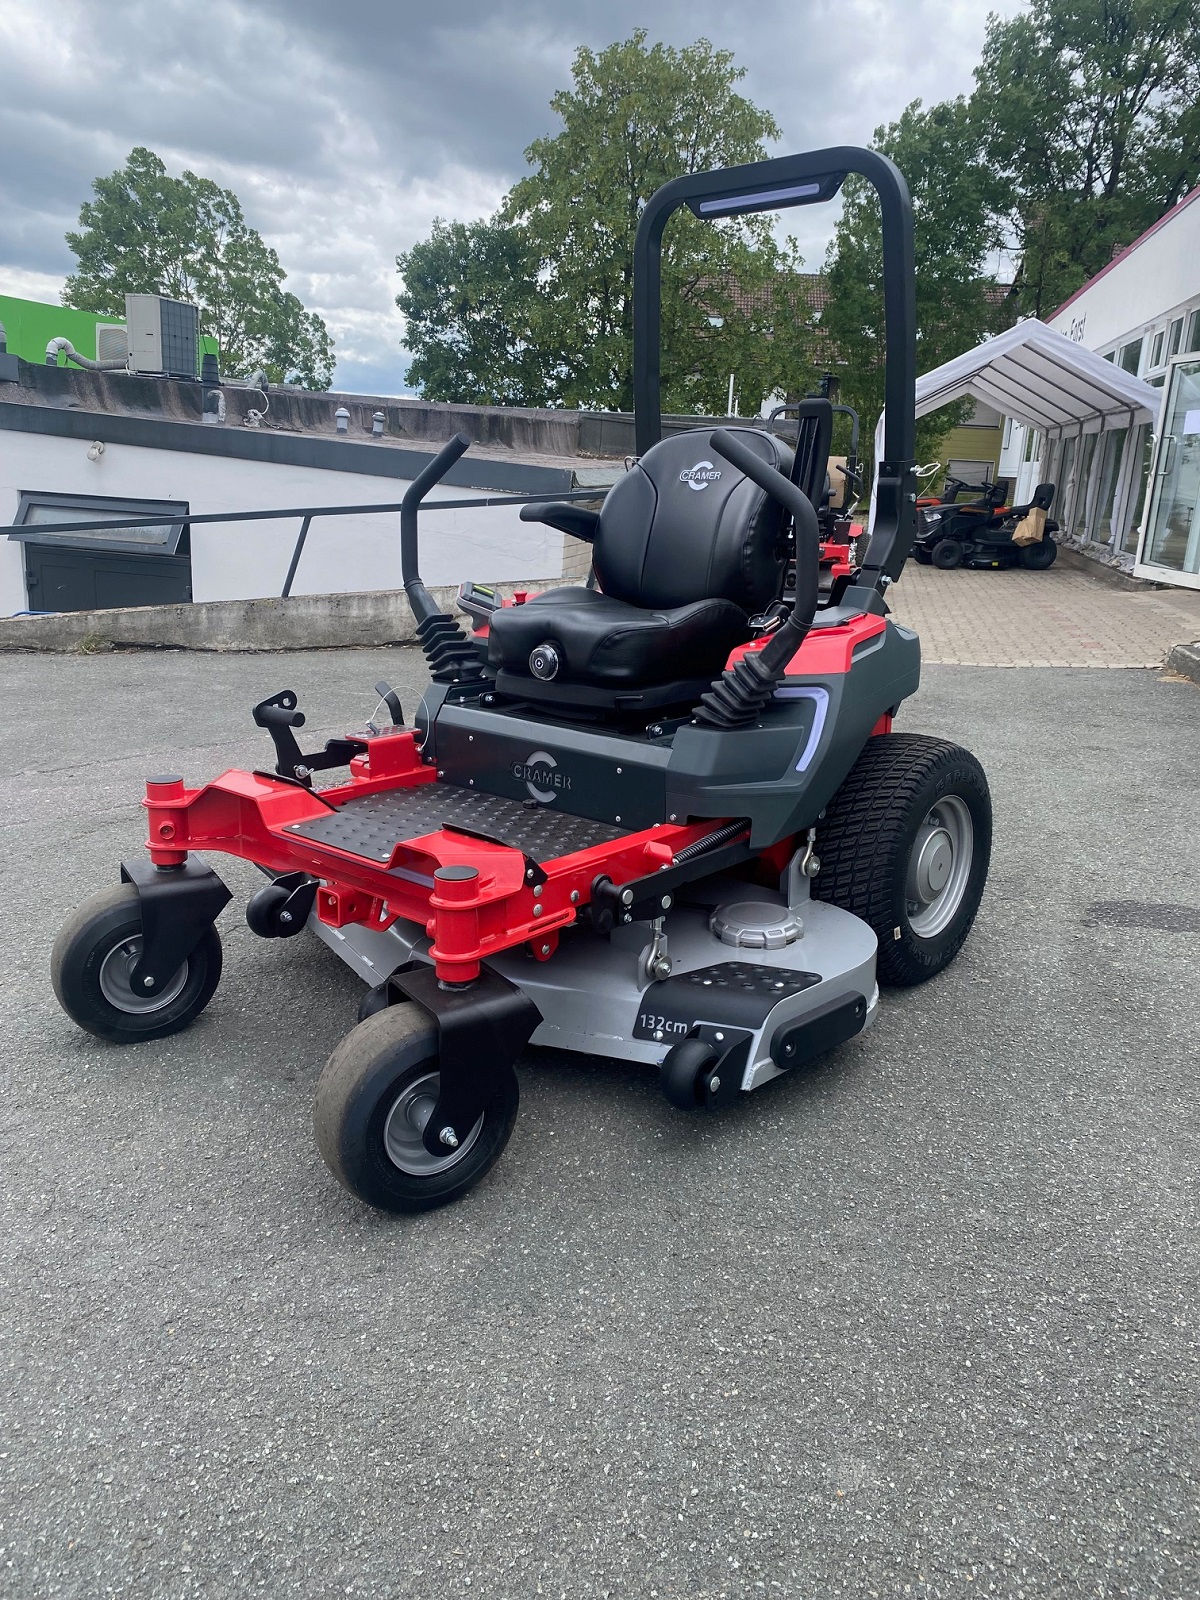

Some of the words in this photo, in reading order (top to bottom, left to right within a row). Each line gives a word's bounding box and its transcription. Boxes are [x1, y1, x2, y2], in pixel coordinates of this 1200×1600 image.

[681, 471, 721, 480] CRAMER
[513, 764, 572, 790] CRAMER
[640, 1013, 688, 1034] 132cm
